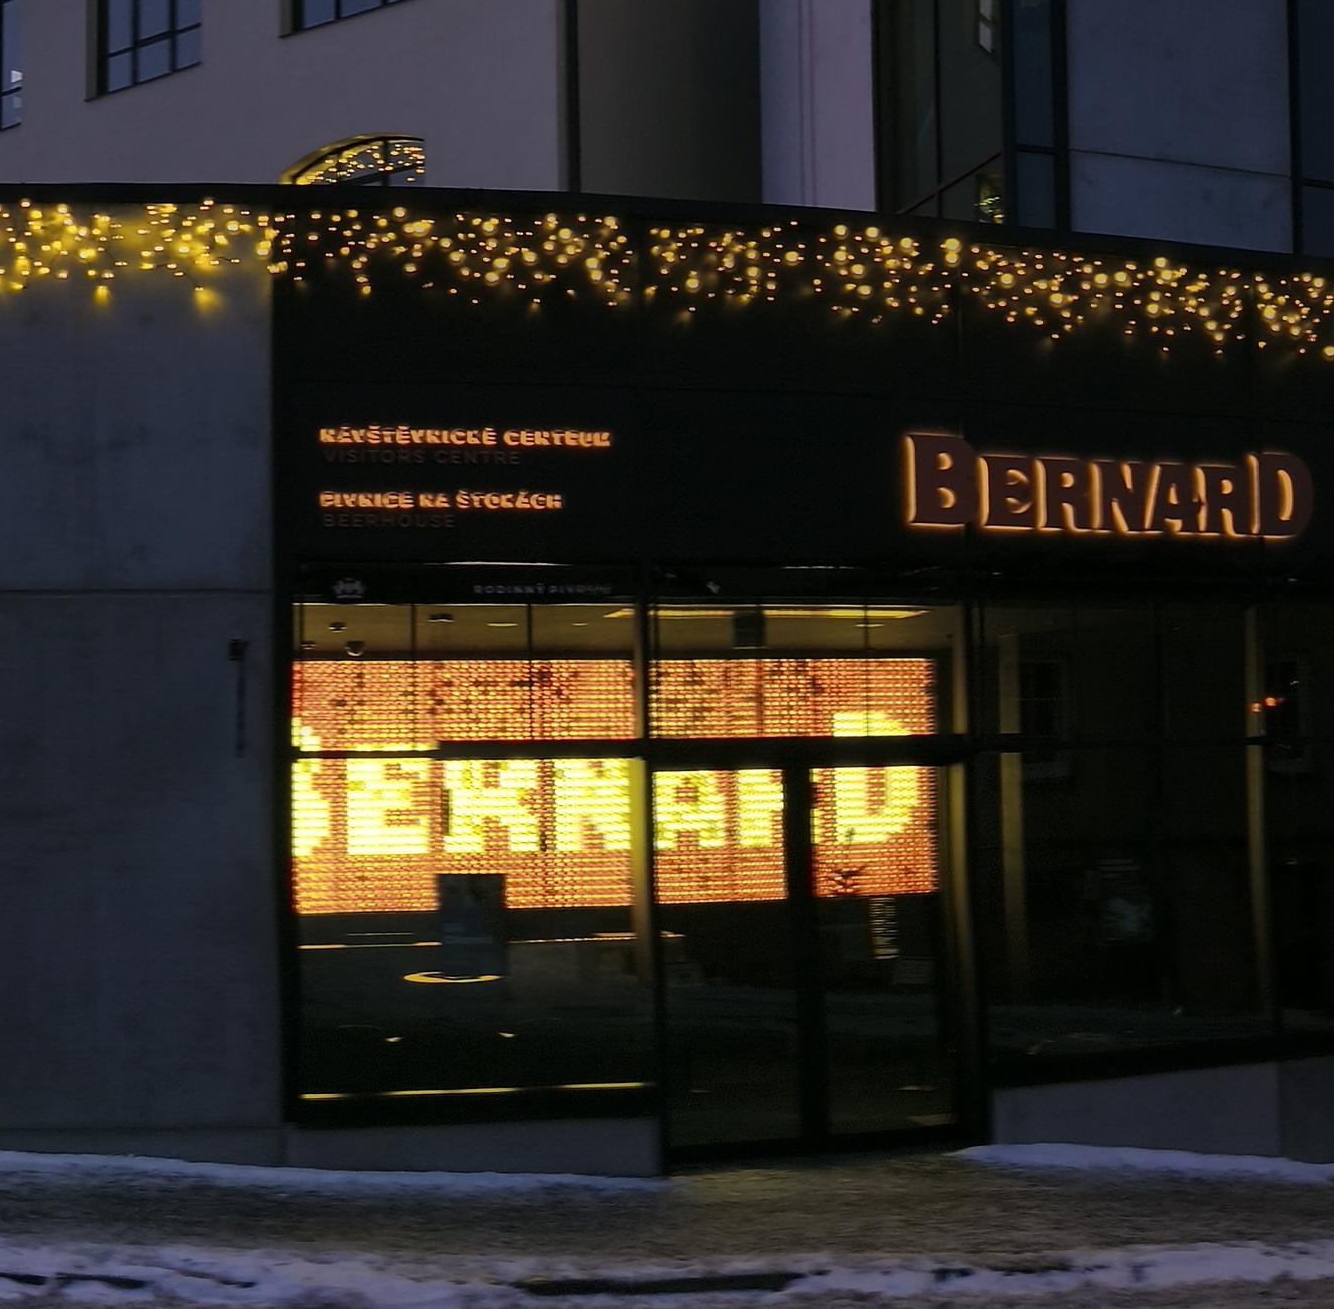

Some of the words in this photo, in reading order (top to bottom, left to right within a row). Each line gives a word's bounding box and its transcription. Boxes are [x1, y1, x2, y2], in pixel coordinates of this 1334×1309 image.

[323, 449, 428, 464] VISITORS
[433, 450, 521, 465] CENTRE
[905, 433, 1313, 539] BERNARD
[323, 513, 455, 529] BEERHOUSE
